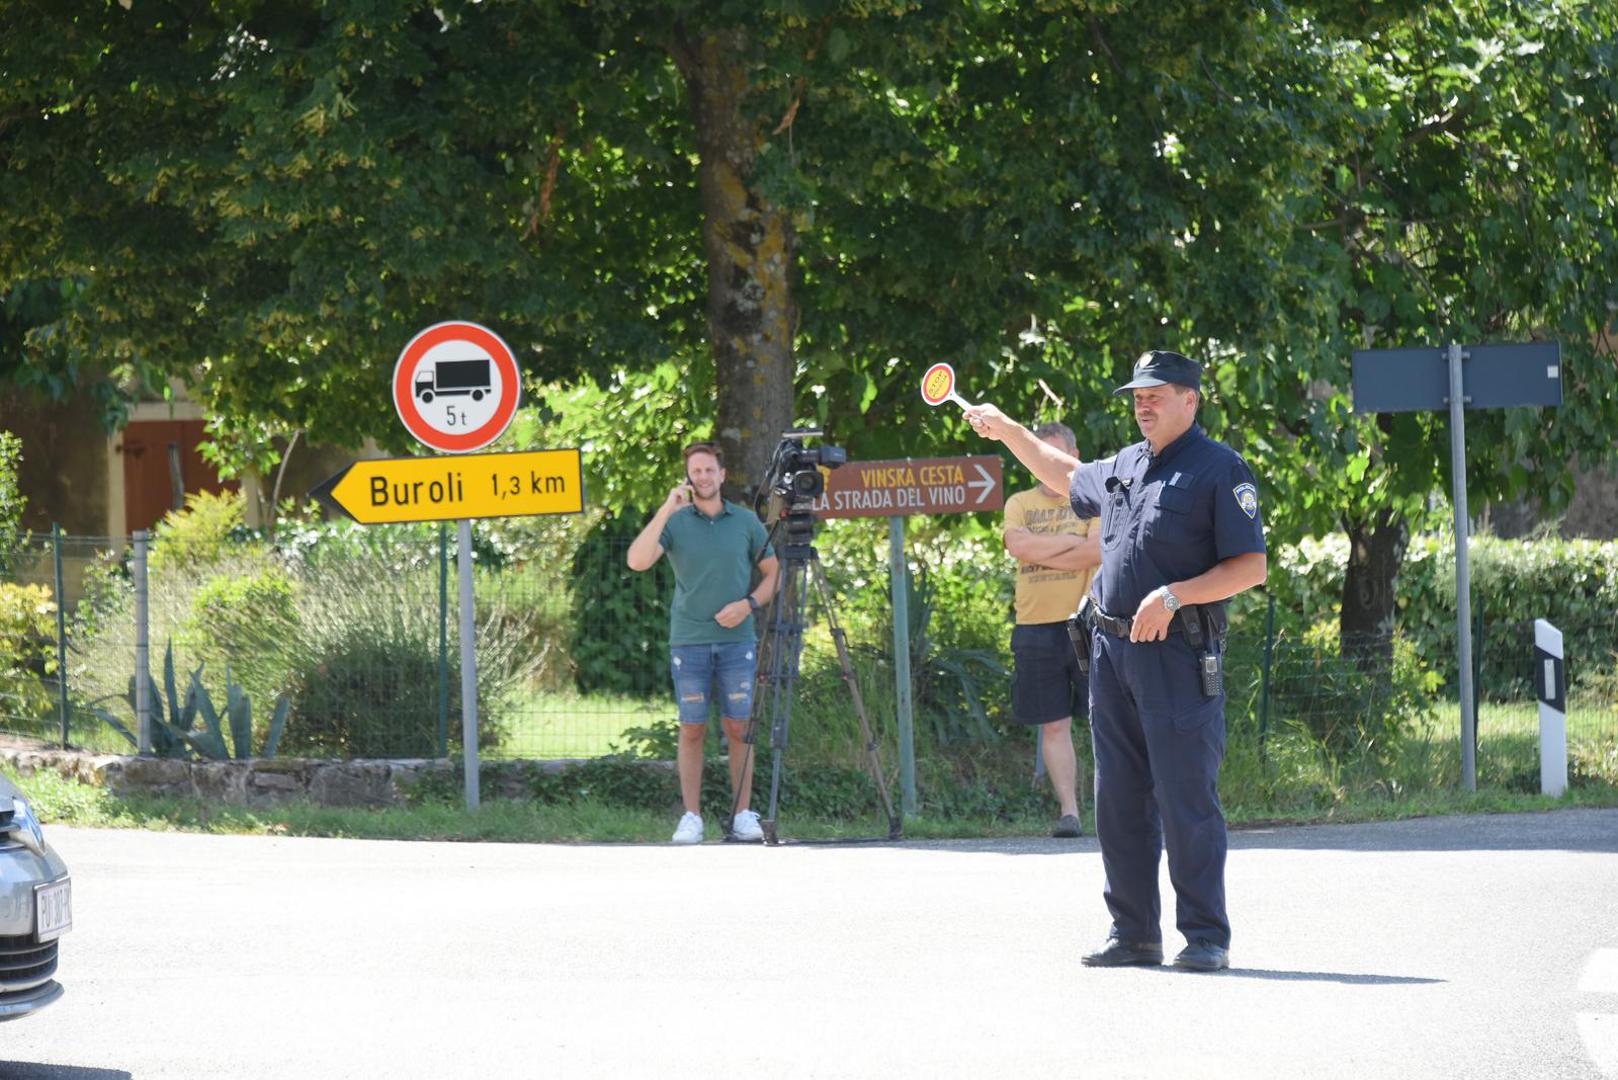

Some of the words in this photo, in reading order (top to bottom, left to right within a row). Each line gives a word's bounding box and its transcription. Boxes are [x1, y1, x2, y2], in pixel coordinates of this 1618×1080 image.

[446, 405, 456, 426] 5
[460, 412, 468, 426] t
[861, 469, 915, 488] VINSKA
[920, 465, 965, 486] CESTA
[371, 472, 463, 506] Buroli
[492, 473, 521, 500] 1,3
[531, 471, 565, 494] km
[835, 491, 892, 510] STRADA
[897, 487, 925, 507] DEL
[928, 486, 965, 505] VINO
